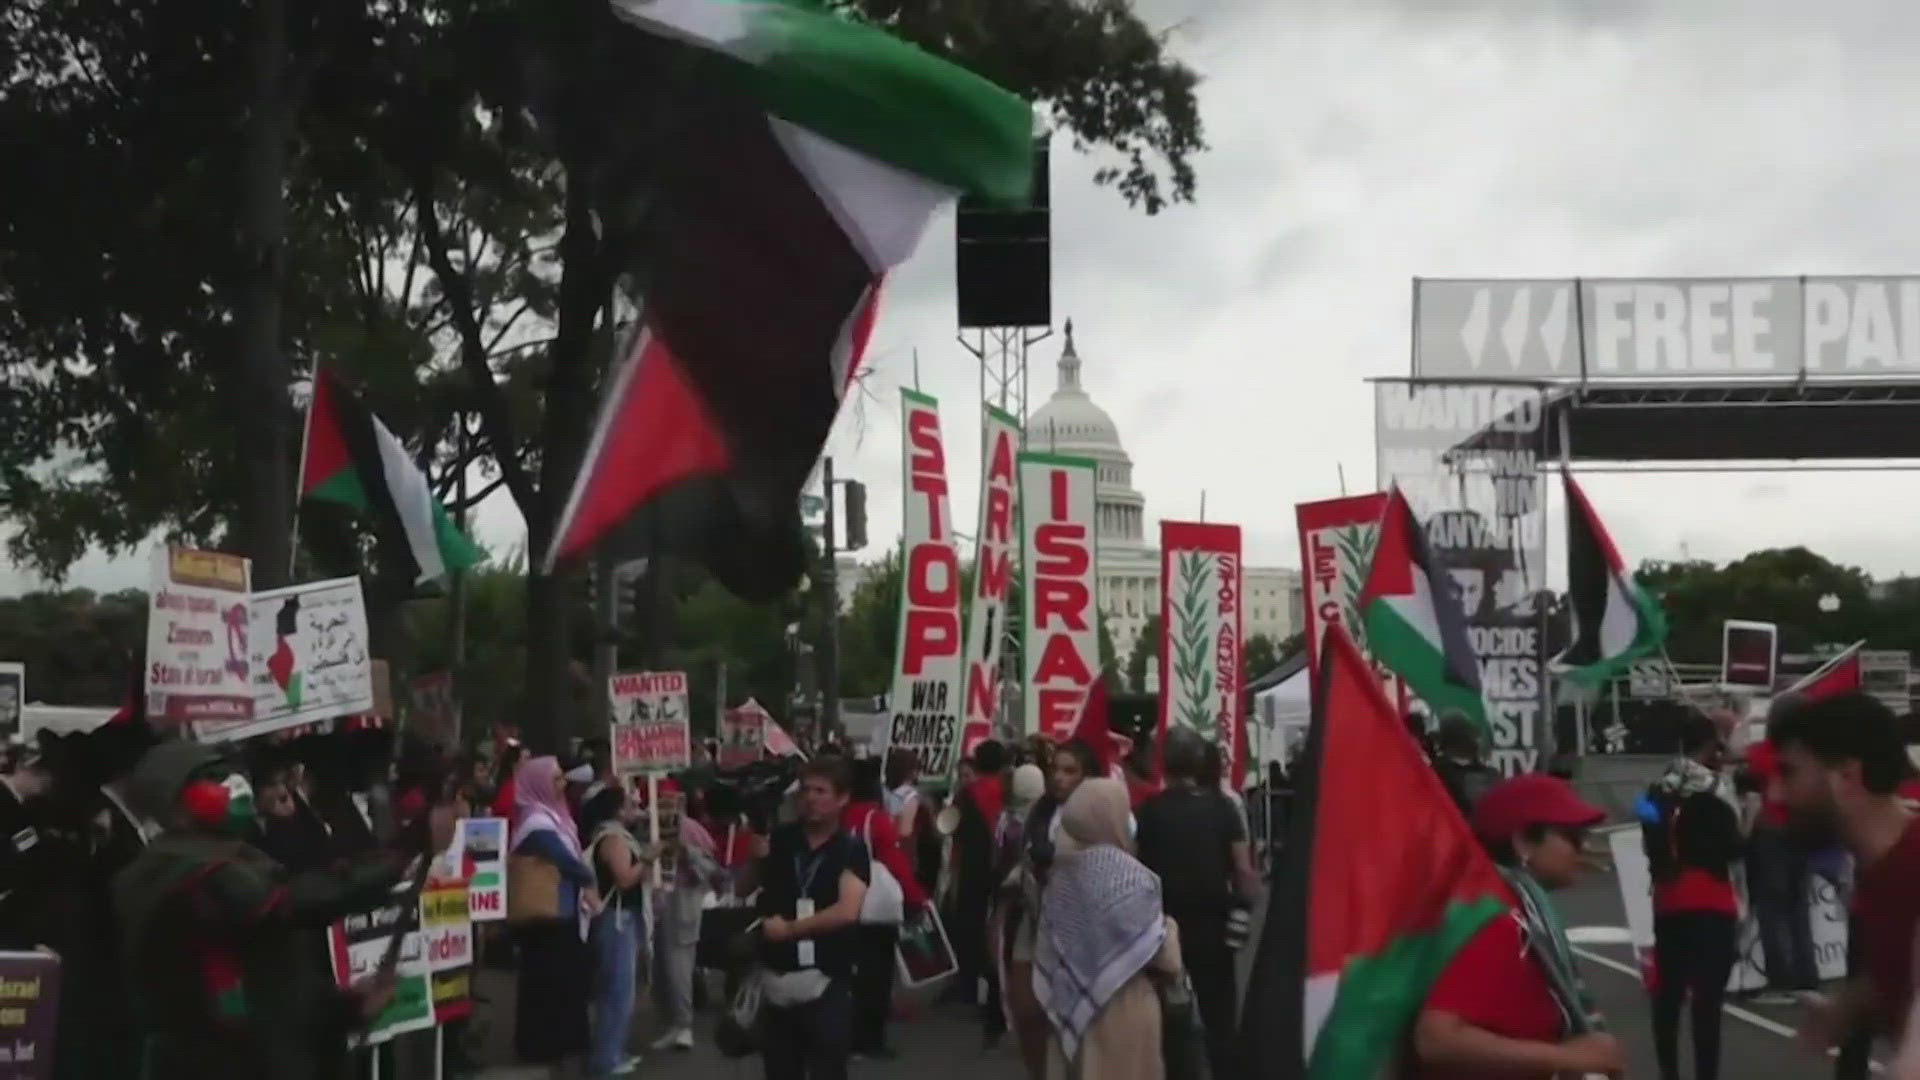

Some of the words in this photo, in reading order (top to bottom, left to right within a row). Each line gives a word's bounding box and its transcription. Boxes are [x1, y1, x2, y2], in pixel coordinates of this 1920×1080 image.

[1596, 284, 1773, 369] FREE
[1384, 387, 1541, 432] WANTED
[903, 409, 957, 676] STOP
[1312, 534, 1336, 594] LET
[1218, 557, 1234, 617] STOP
[614, 675, 682, 696] WANTED
[911, 681, 948, 711] WAR
[891, 713, 956, 745] CRIMES
